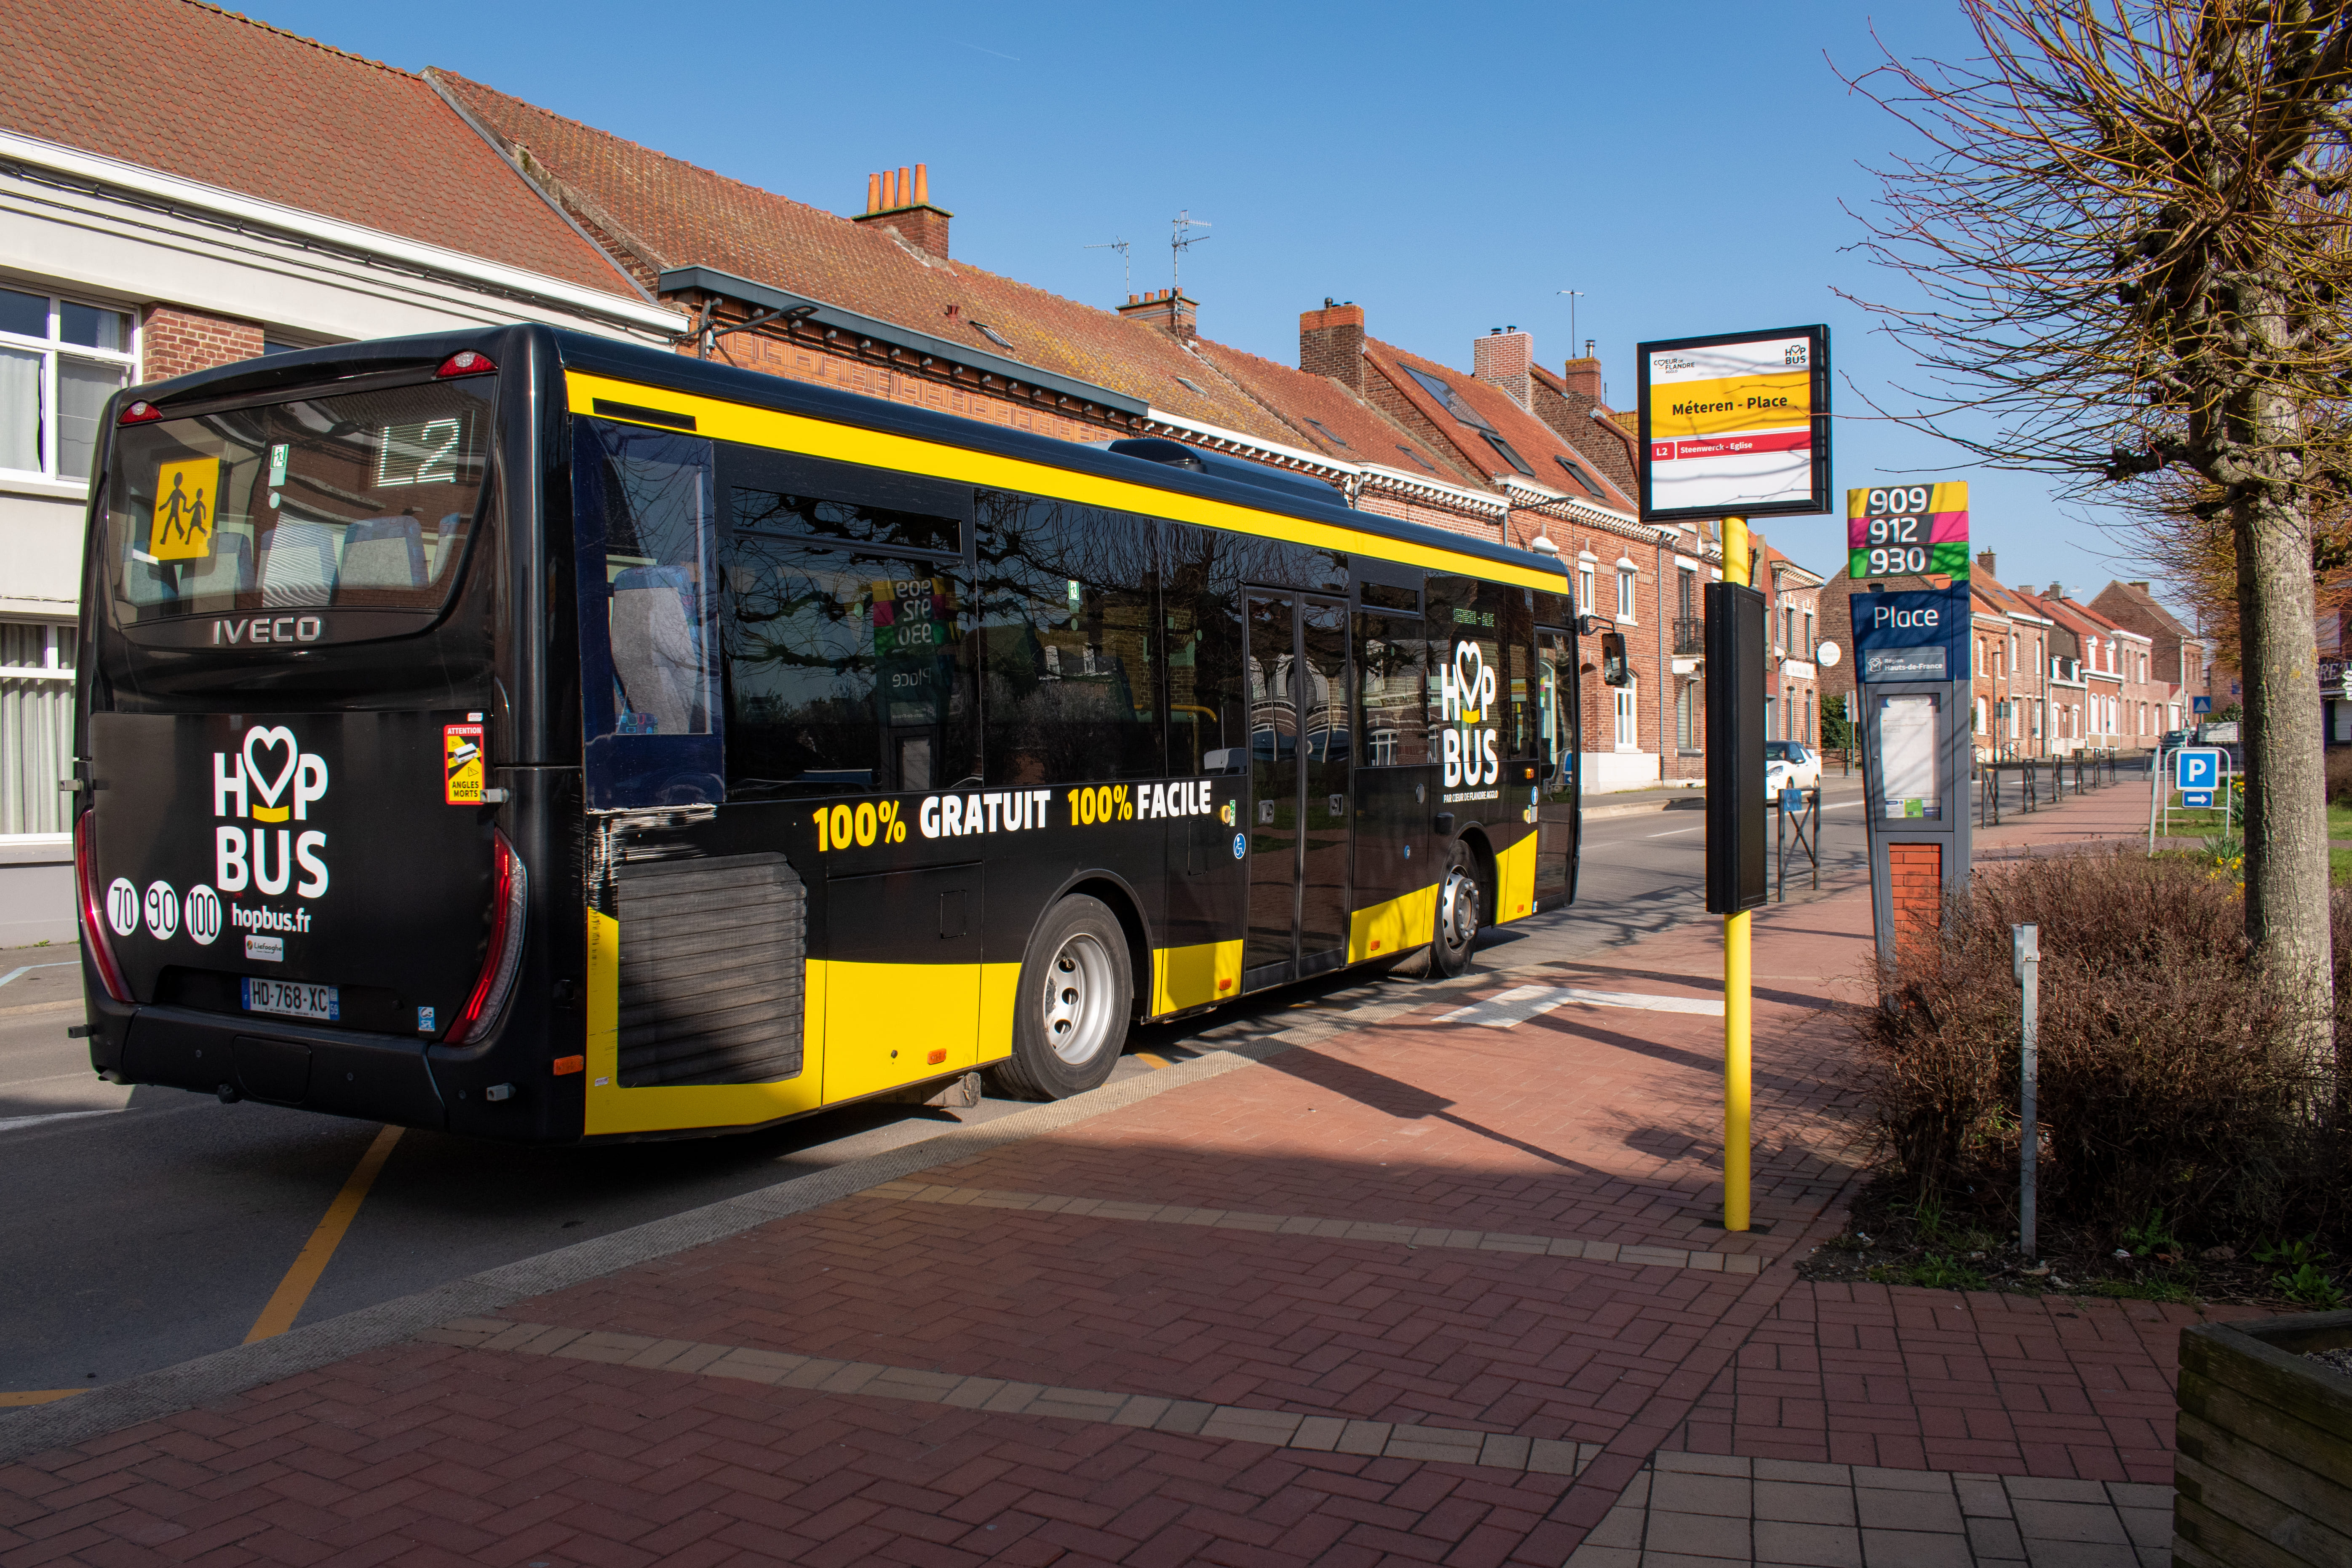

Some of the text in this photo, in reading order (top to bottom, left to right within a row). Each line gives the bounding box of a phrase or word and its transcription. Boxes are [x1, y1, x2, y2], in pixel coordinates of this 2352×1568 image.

[1665, 362, 1695, 370] FLANDRE
[1785, 356, 1806, 365] BUS
[1672, 400, 1733, 416] Méteren
[1747, 396, 1788, 409] Place
[377, 418, 460, 487] L2
[1656, 447, 1668, 457] L2
[1680, 443, 1724, 454] Steenwerck
[1730, 442, 1753, 451] Eglise
[1869, 487, 1927, 516] 909
[1870, 517, 1918, 545] 912
[1870, 546, 1927, 574] 930
[212, 617, 321, 645] IVECO
[1874, 606, 1939, 629] Place
[1884, 663, 1943, 671] Hauts-de-France
[1443, 728, 1499, 788] BUS
[2189, 759, 2207, 782] P
[1443, 794, 1452, 803] PAR
[1464, 793, 1470, 801] DE
[1469, 791, 1486, 801] FLANDRE
[1486, 790, 1499, 799] AGGLO
[813, 780, 1211, 852] 100% GRATUIT 100% FACILE
[216, 826, 329, 898] BUS
[113, 886, 134, 929] 70
[149, 889, 176, 932] 90
[190, 892, 217, 937] 100
[232, 903, 312, 933] hopbus.fr
[254, 942, 282, 954] Liefooghe
[253, 981, 327, 1012] HD-768-XC
